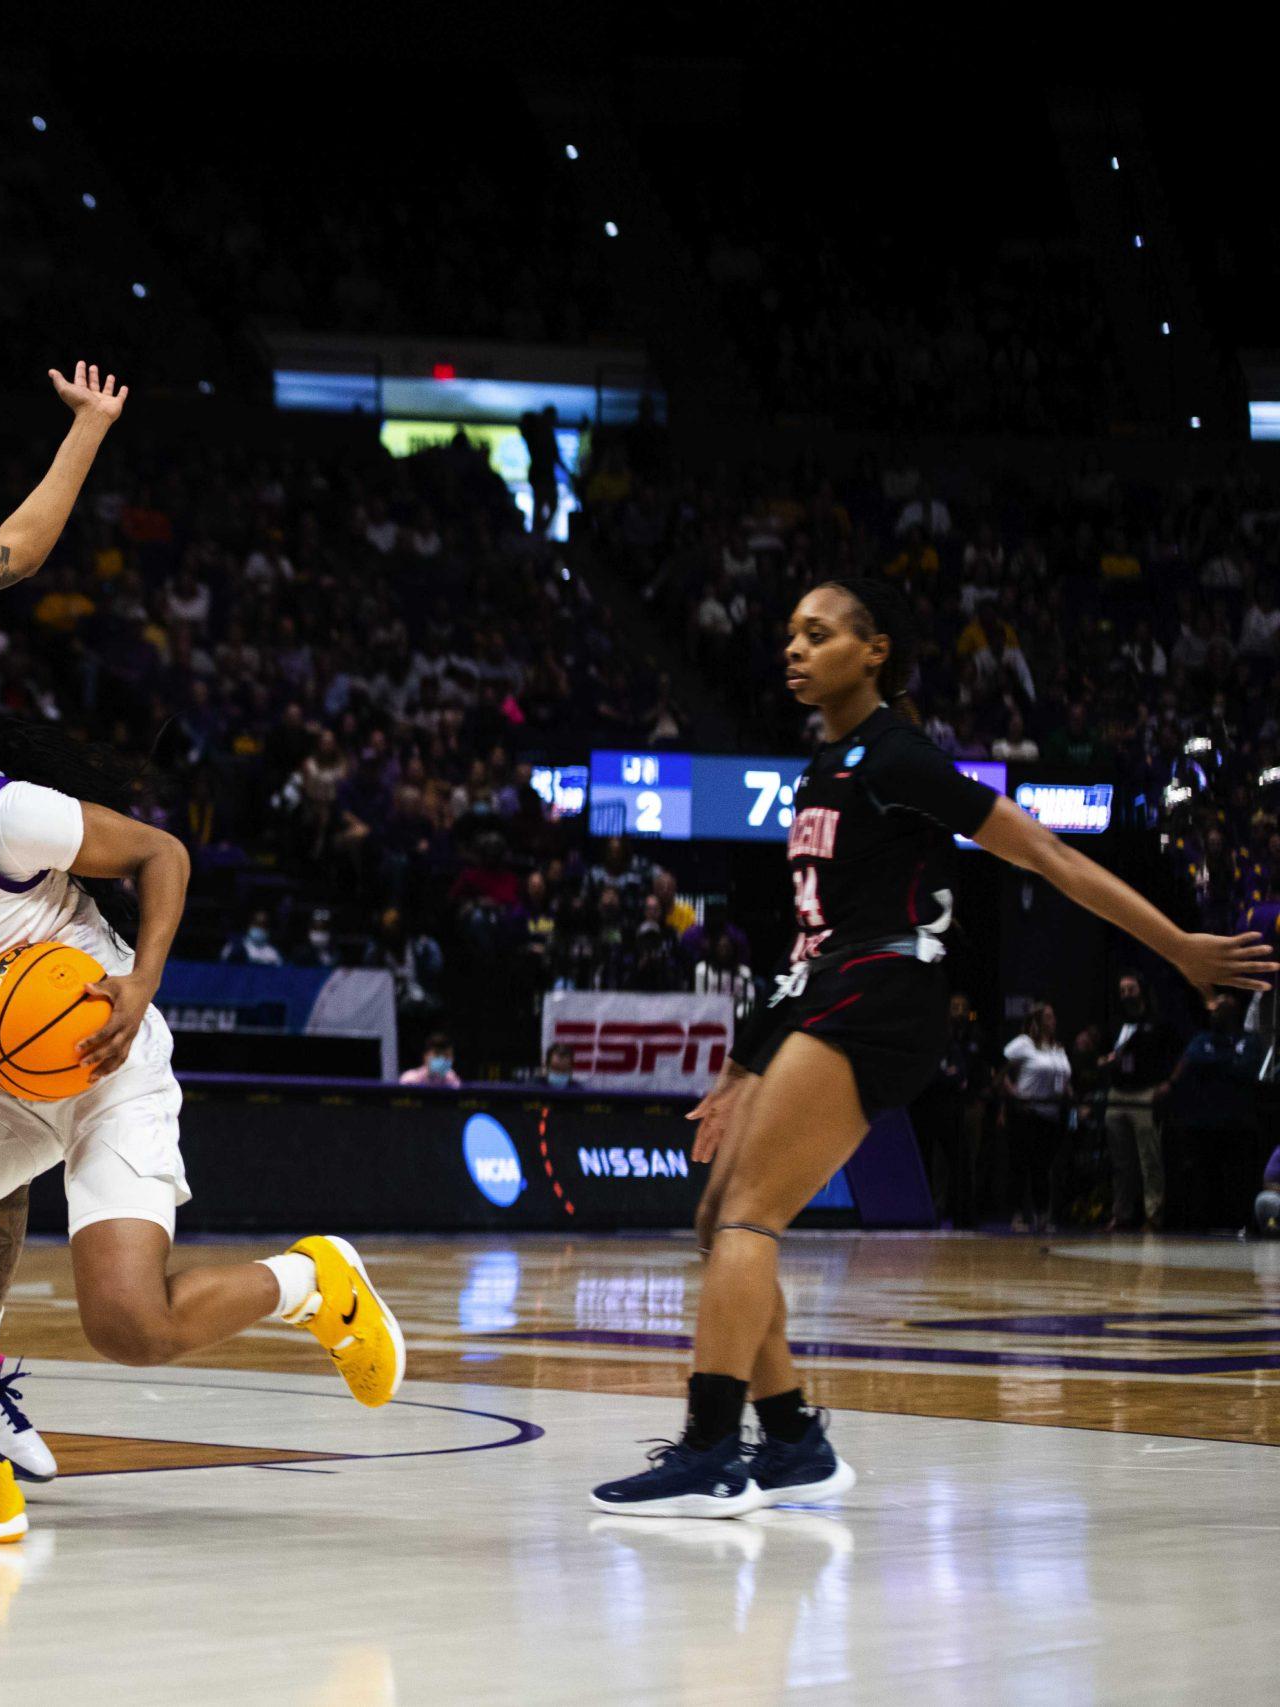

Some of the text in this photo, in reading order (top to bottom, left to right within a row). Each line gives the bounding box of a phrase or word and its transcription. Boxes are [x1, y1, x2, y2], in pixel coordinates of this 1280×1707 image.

[636, 790, 662, 832] 2
[554, 1021, 727, 1076] ESPN
[577, 1147, 689, 1178] NISSAN
